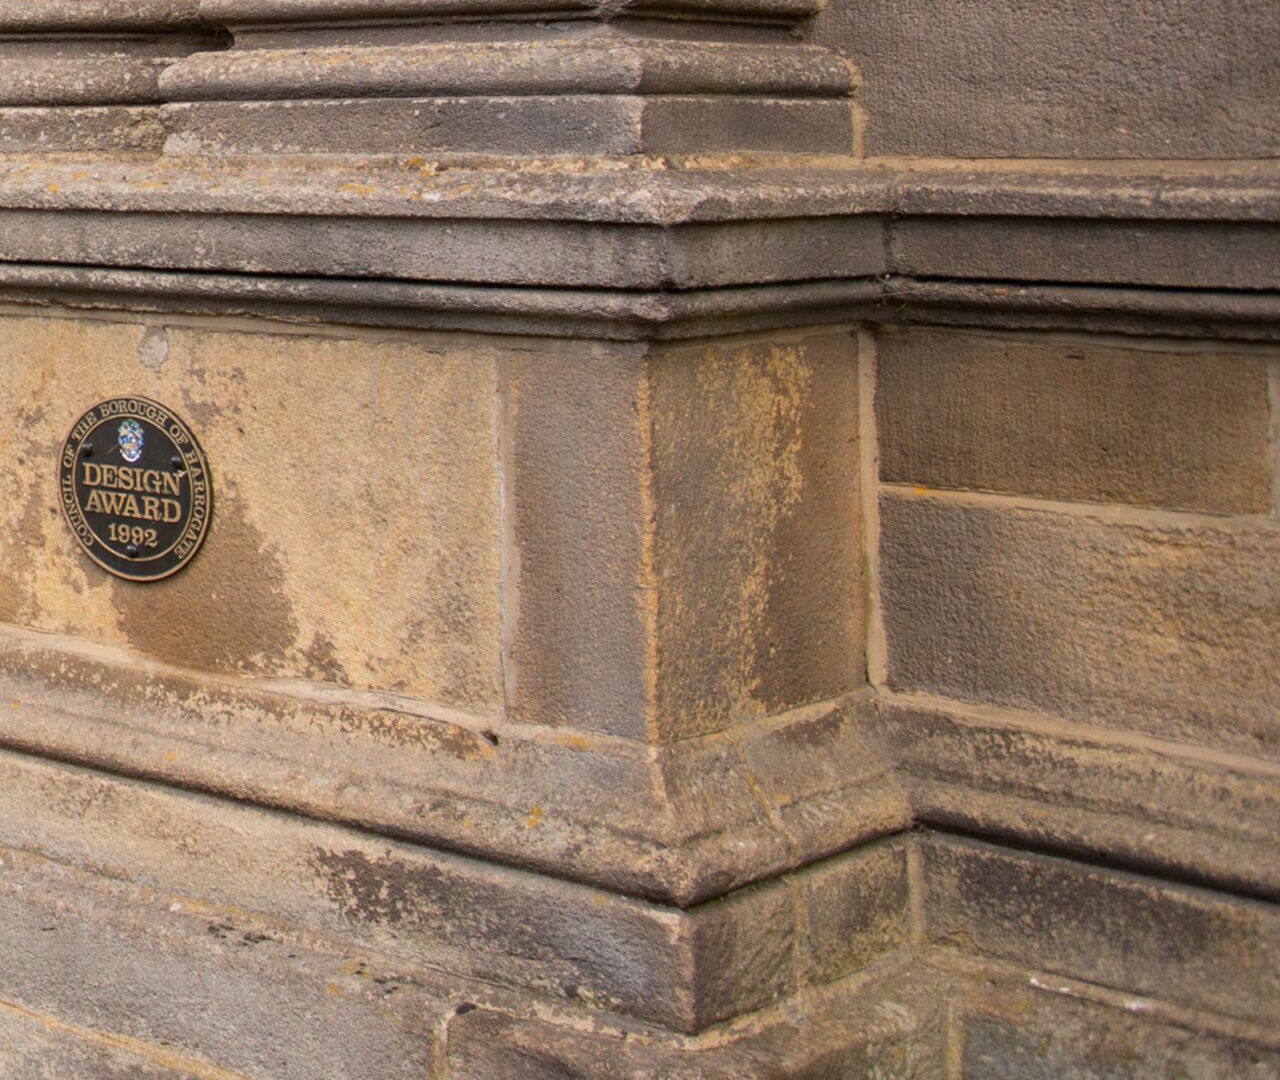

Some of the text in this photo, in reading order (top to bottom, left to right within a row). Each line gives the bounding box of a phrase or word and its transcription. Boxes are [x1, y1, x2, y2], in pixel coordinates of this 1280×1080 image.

[62, 400, 206, 559] COUNCIL OF THE BOROUGH OF HARROGATE
[83, 463, 181, 496] DESIGN
[85, 490, 182, 523] AWARD
[108, 523, 158, 548] 1992
